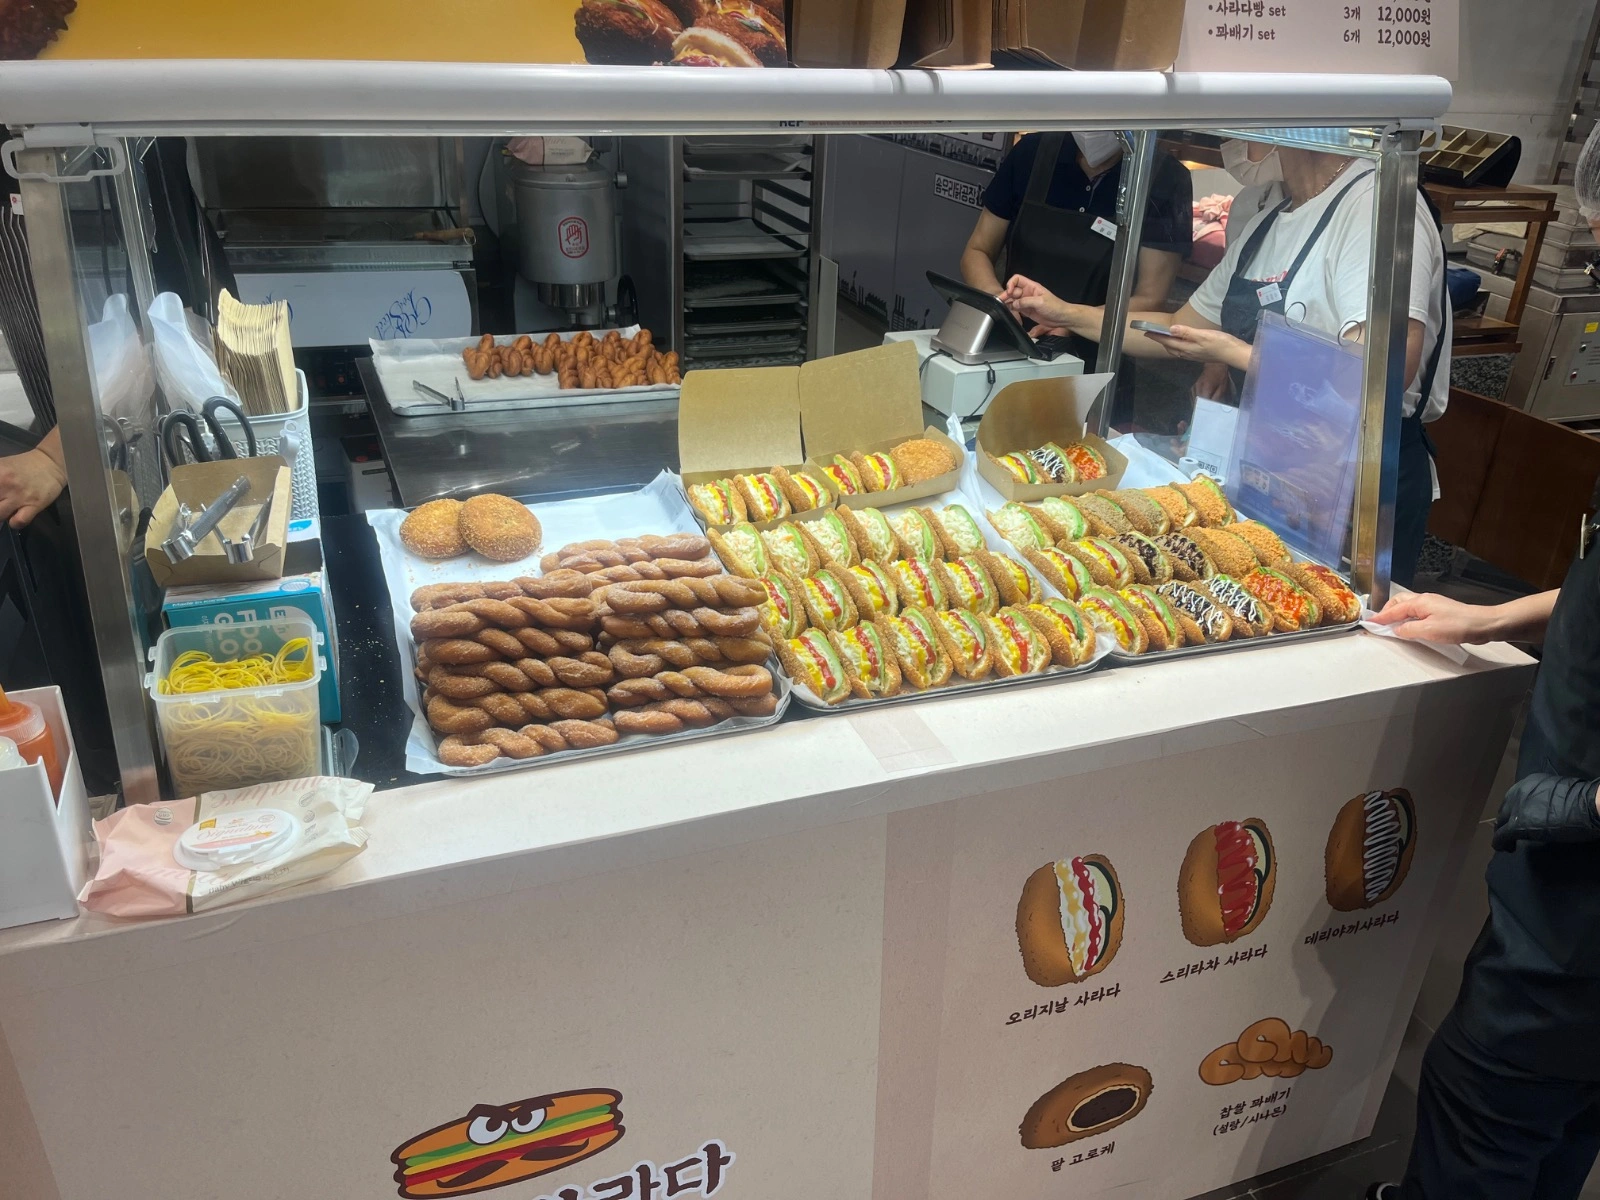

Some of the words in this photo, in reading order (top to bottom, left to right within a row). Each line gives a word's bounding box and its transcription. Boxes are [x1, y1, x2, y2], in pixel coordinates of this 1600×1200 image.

[1216, 0, 1264, 17] 사라다빵
[1269, 6, 1286, 17] set
[1343, 6, 1361, 20] 3개
[1377, 6, 1431, 25] 12,000원
[1216, 24, 1253, 40] 꽈배기
[1257, 30, 1275, 40] set
[1343, 29, 1360, 44] 6개
[1377, 29, 1431, 47] 12,000원
[1304, 910, 1399, 945] 데리야끼사라다
[1159, 957, 1220, 984] 스리라차
[1223, 945, 1268, 967] 사라다
[1005, 997, 1068, 1026] 오리지날
[1074, 983, 1121, 1008] 사라다
[1220, 1101, 1247, 1119] 찹쌀
[1250, 1087, 1291, 1109] 꽈배기
[538, 1143, 731, 1200] 라다
[1051, 1157, 1065, 1172] 팥
[1069, 1141, 1116, 1166] 고로케
